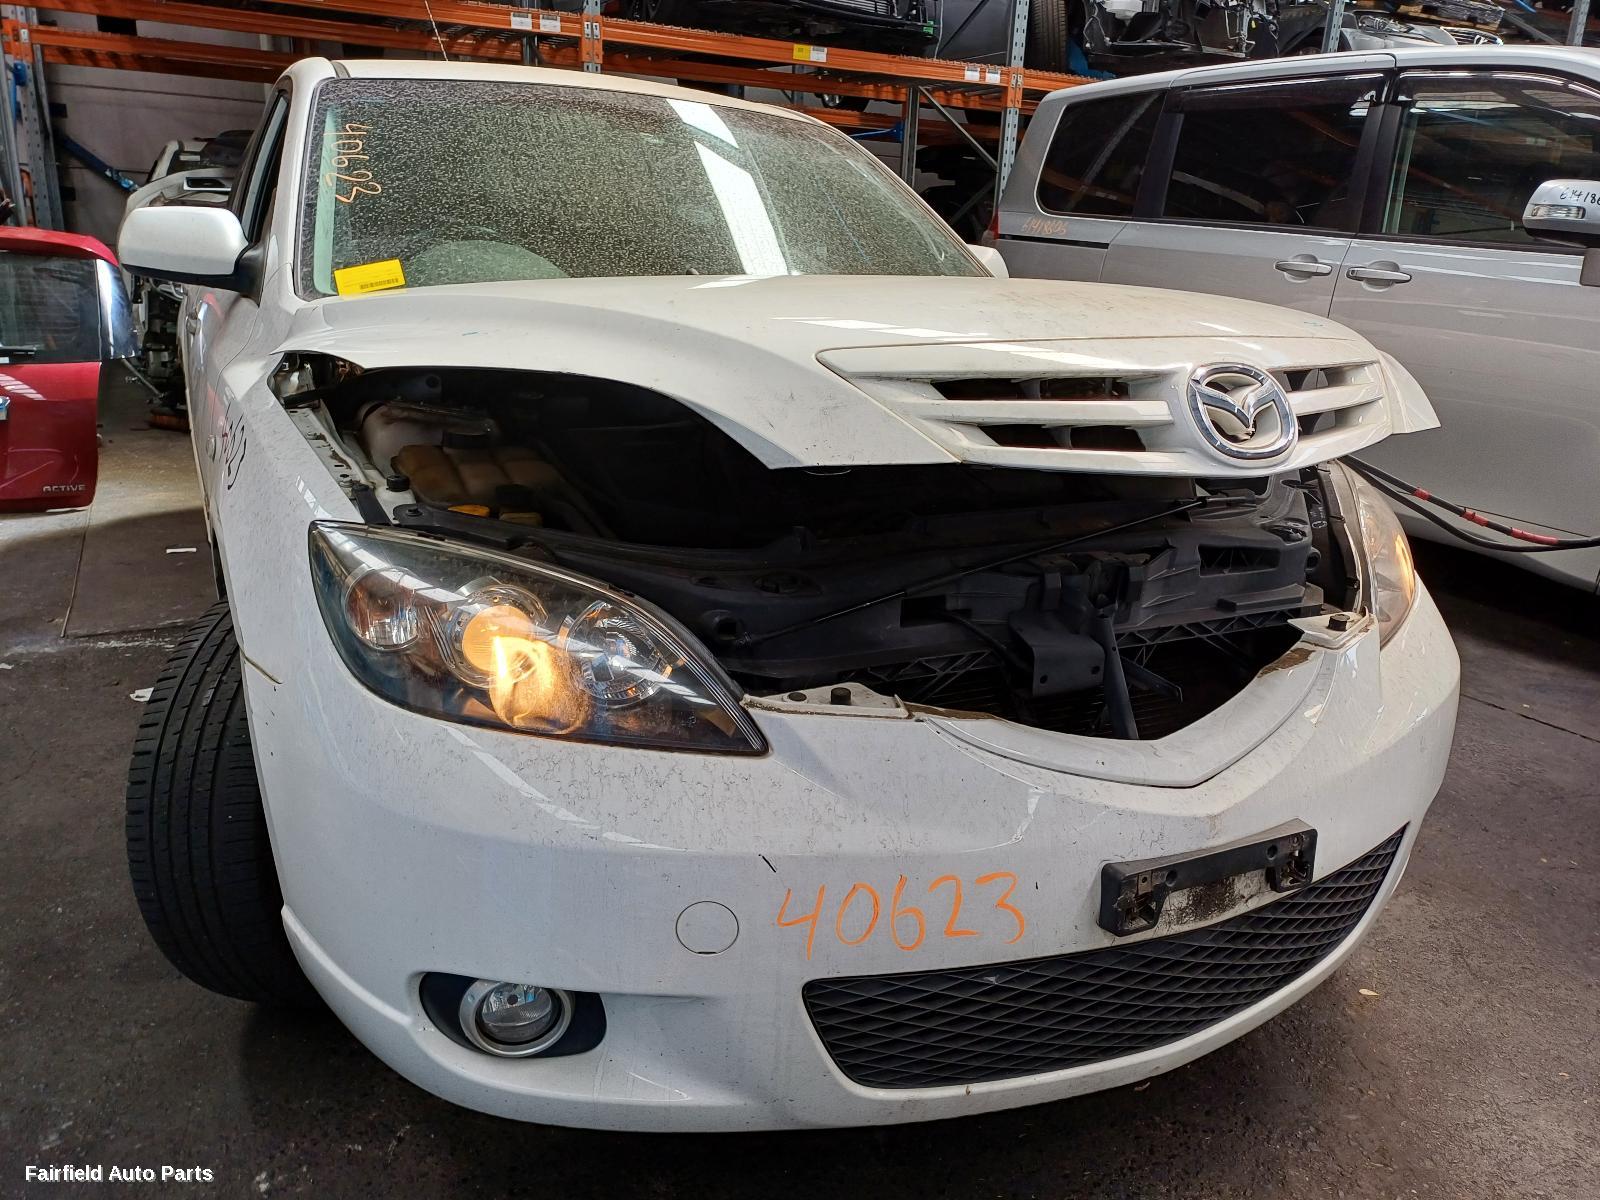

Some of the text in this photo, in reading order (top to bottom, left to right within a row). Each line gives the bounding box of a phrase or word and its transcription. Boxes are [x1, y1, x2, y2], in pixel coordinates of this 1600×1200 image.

[323, 123, 382, 203] 40623
[43, 484, 87, 492] ACTIVE
[776, 871, 1026, 960] 40623
